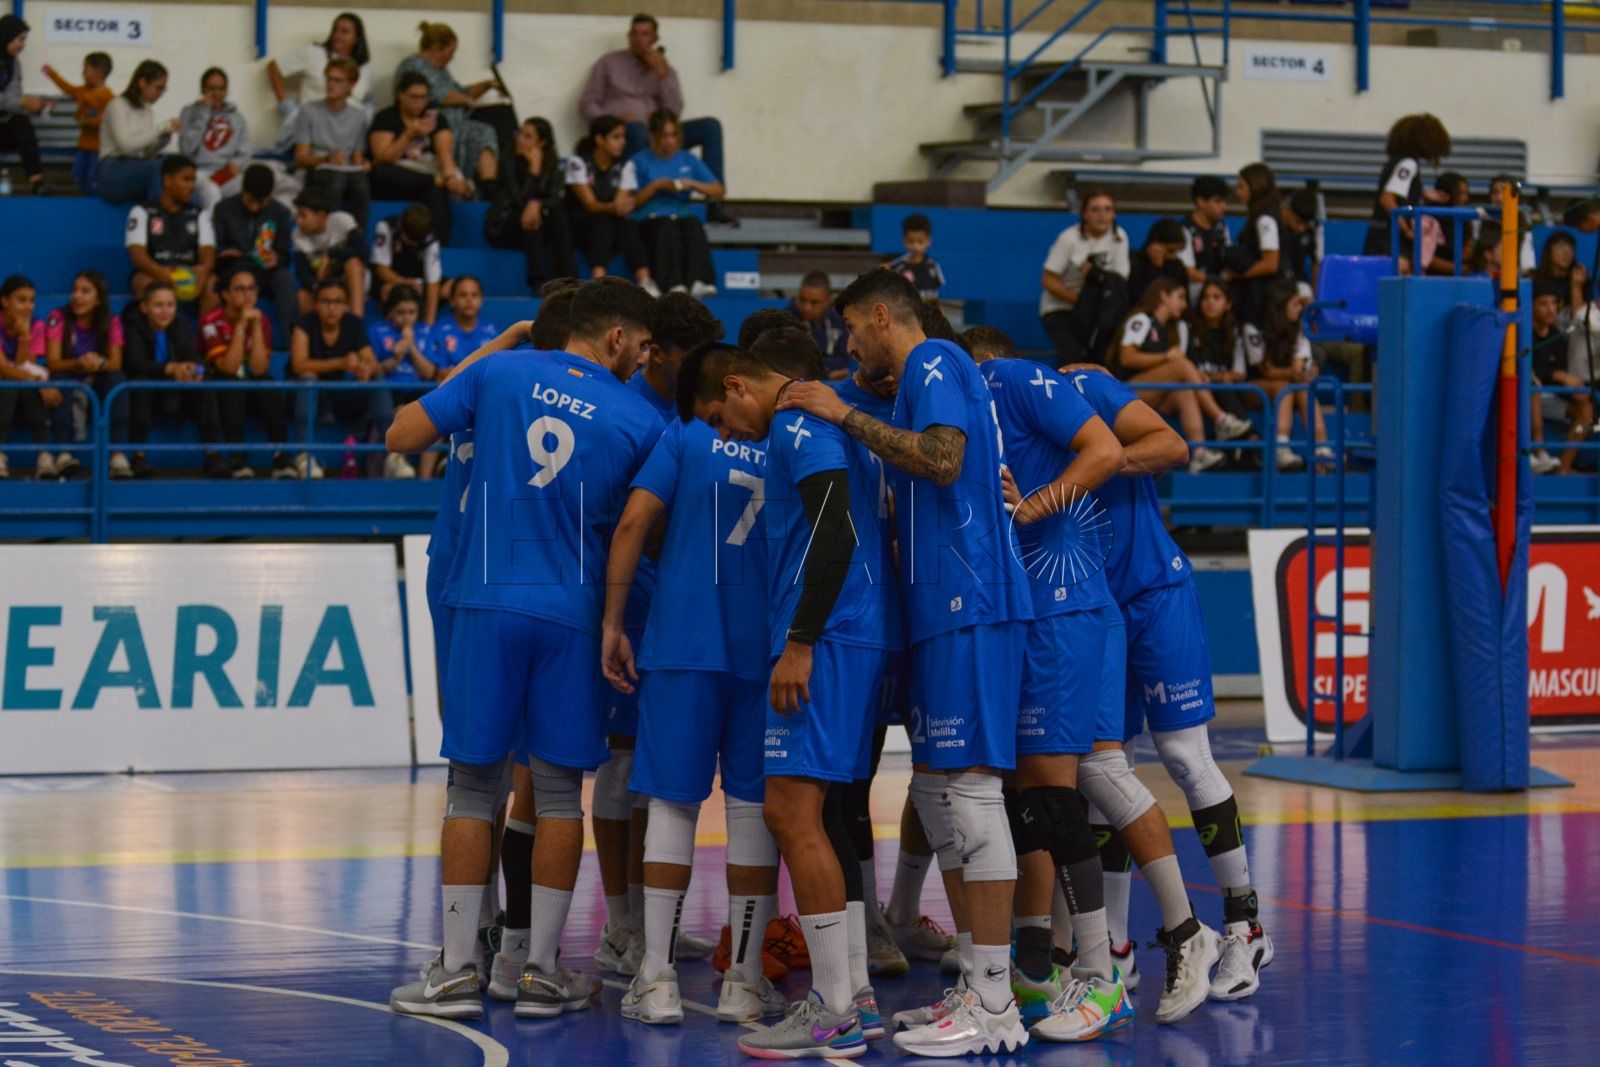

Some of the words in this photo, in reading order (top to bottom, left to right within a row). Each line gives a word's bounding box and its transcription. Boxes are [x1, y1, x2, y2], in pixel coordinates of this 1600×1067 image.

[54, 18, 119, 32] SECTOR
[127, 20, 143, 40] 3
[1252, 56, 1306, 69] SECTOR
[1312, 58, 1325, 75] 4
[532, 383, 597, 420] LOPEZ
[527, 415, 575, 489] 9
[712, 438, 767, 467] PORT
[725, 468, 766, 547] 7
[1171, 688, 1199, 703] Melilla
[930, 715, 965, 727] Televisión
[930, 727, 957, 738] Melilla
